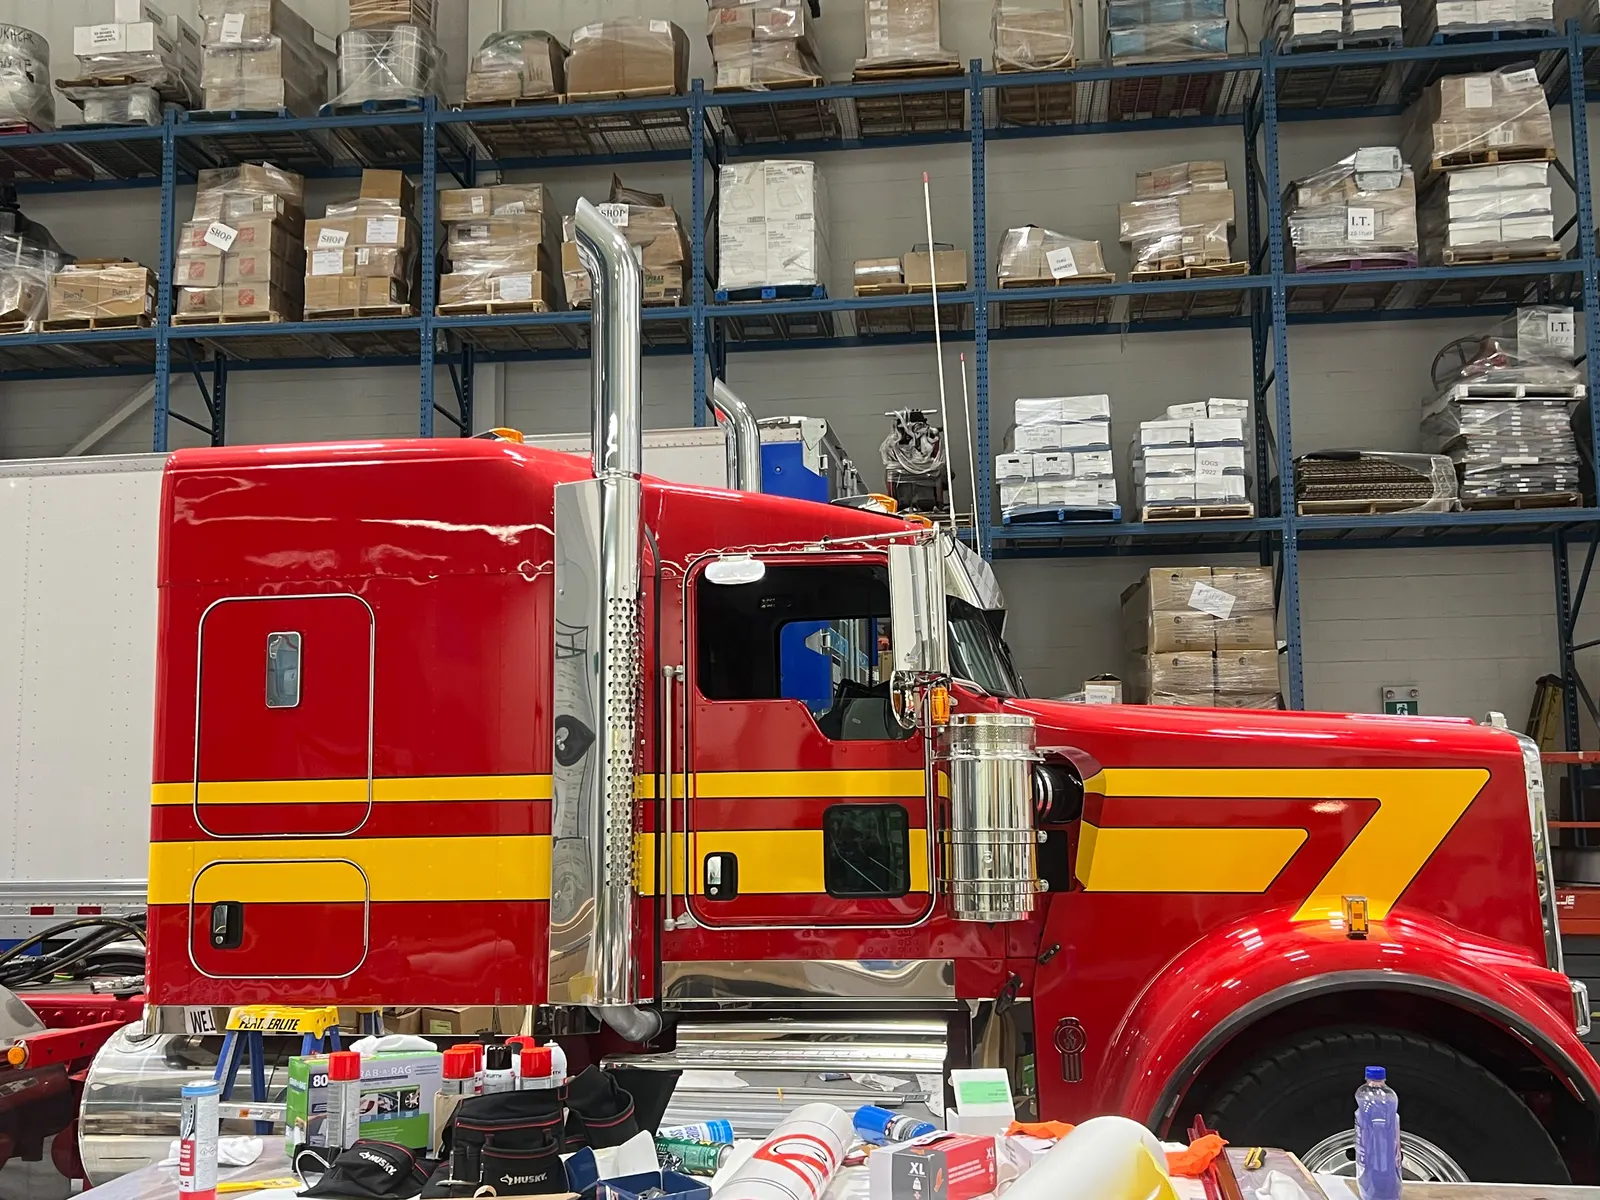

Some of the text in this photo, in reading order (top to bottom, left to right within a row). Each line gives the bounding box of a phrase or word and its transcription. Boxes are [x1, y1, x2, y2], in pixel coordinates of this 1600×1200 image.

[601, 209, 626, 217] SHOP
[1351, 216, 1371, 226] I.T.
[209, 226, 232, 242] SHOP
[321, 234, 344, 244] SHOP
[1551, 322, 1570, 332] I.T.
[368, 1154, 397, 1176] HUSKY
[909, 1162, 926, 1175] XL
[513, 1172, 547, 1184] HUSKY
